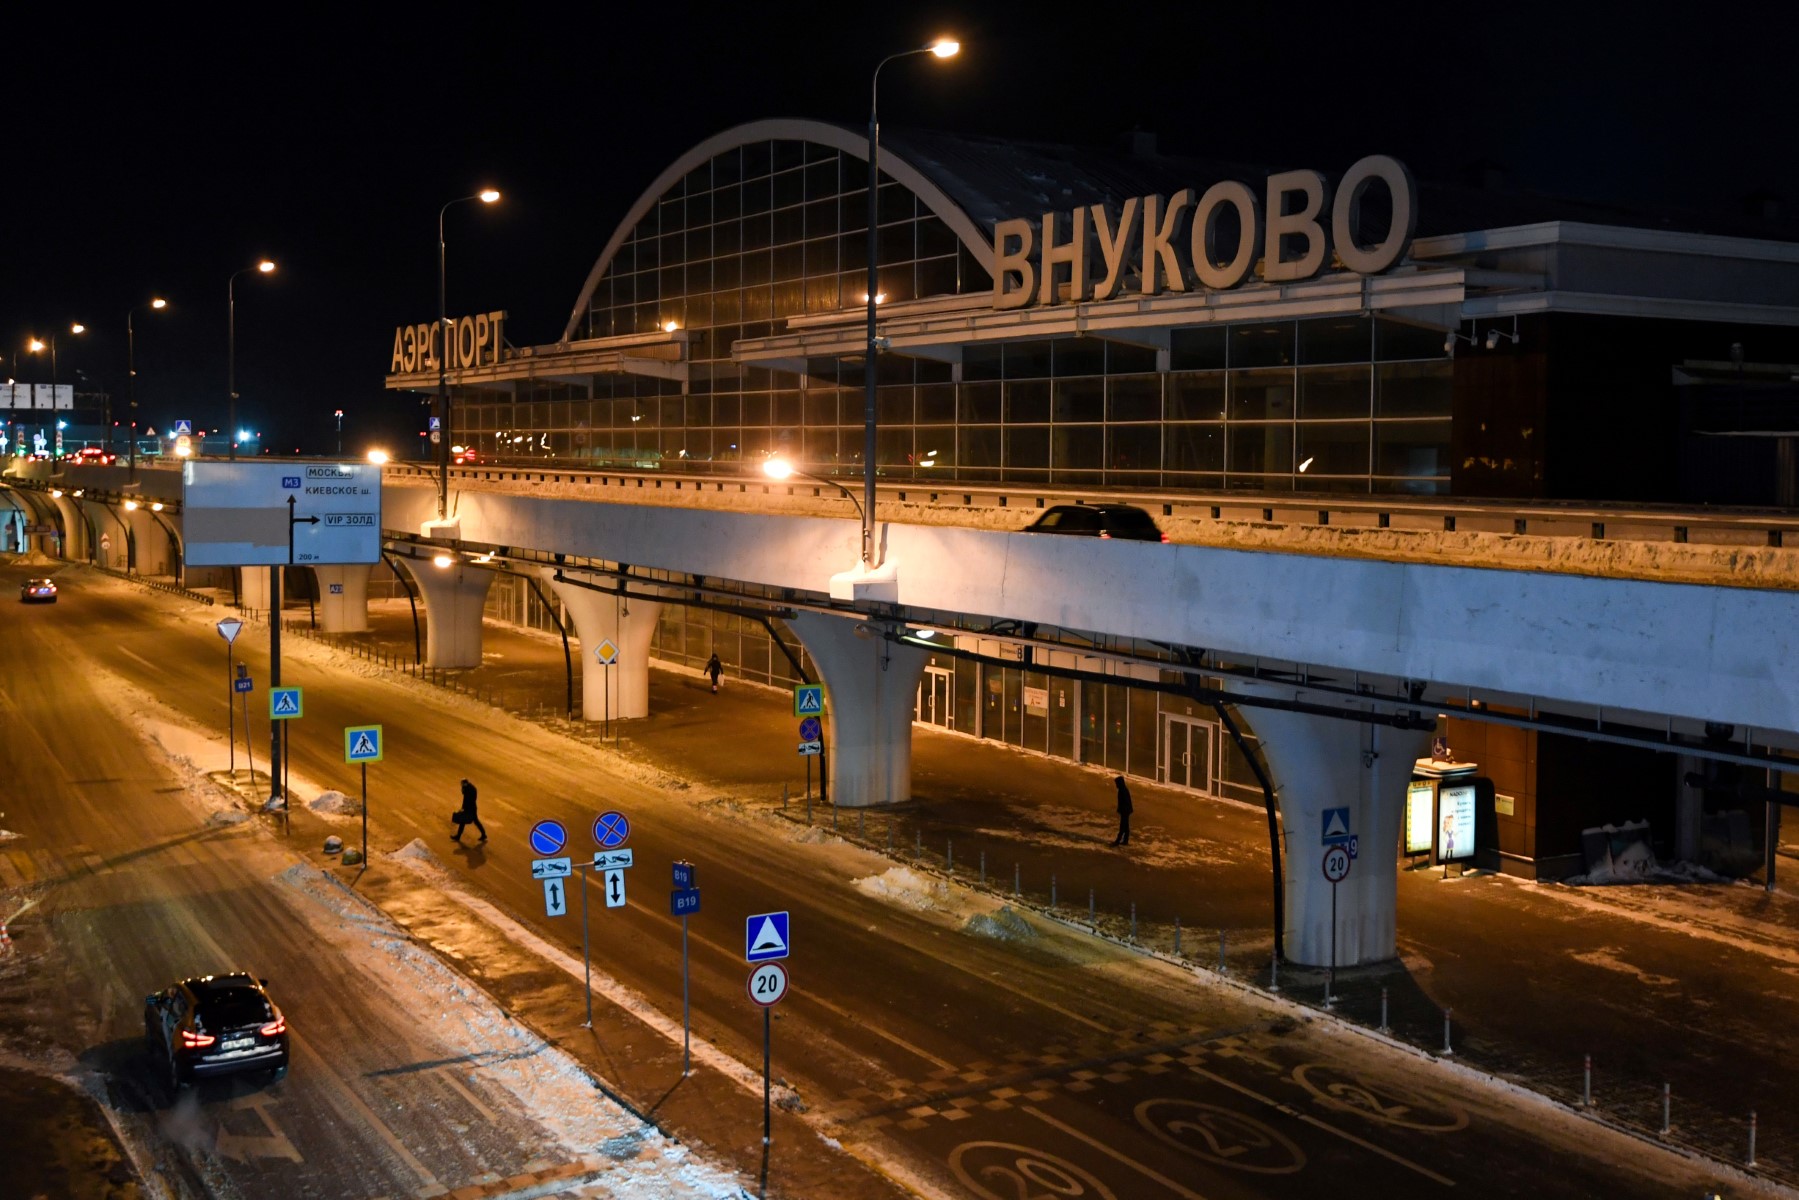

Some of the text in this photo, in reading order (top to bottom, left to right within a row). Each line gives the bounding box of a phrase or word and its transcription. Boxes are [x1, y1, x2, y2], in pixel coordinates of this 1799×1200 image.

[993, 155, 1415, 309] ВНУКОВО
[391, 310, 504, 373] АЭРОПОРТ
[305, 486, 358, 495] КИЕВСКОЕ
[327, 515, 343, 525] VIP
[298, 553, 313, 561] 200
[1330, 856, 1344, 872] 20
[757, 974, 778, 994] 20
